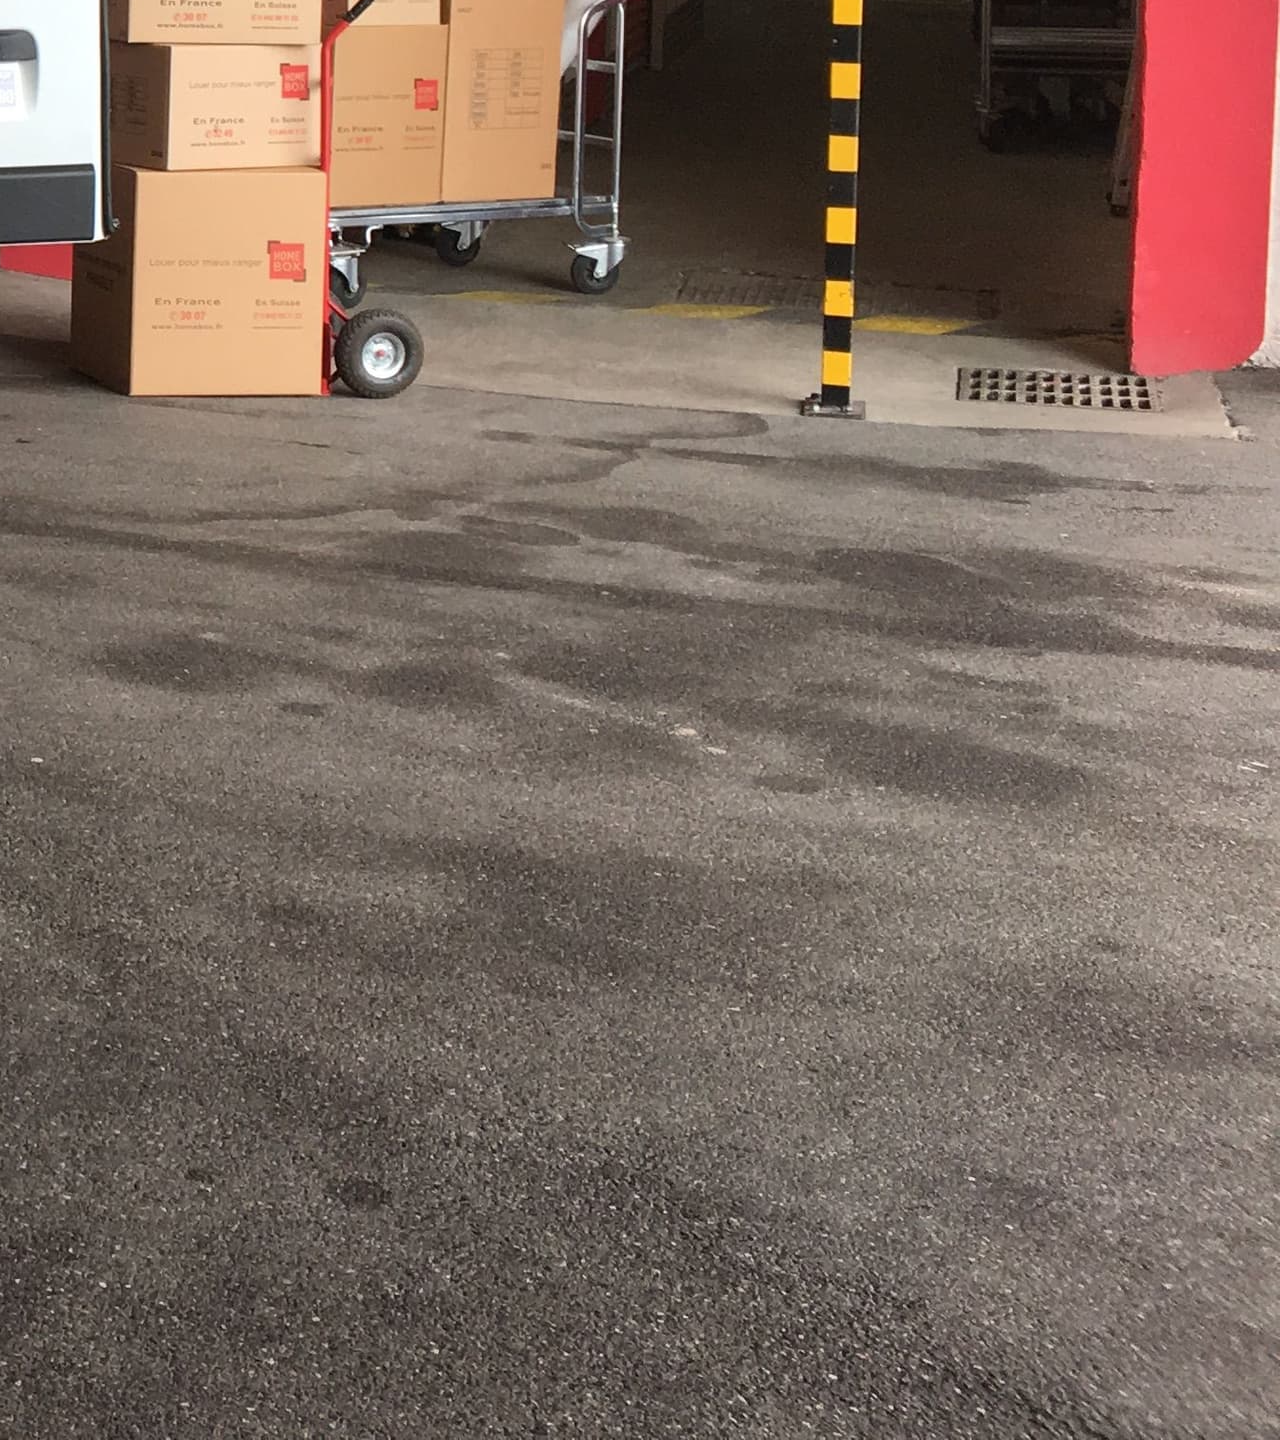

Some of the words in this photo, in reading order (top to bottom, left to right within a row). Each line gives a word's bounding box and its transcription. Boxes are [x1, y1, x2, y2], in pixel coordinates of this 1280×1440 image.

[272, 251, 302, 261] HOME
[272, 261, 303, 273] BOX
[154, 297, 172, 306] En
[175, 297, 222, 306] France
